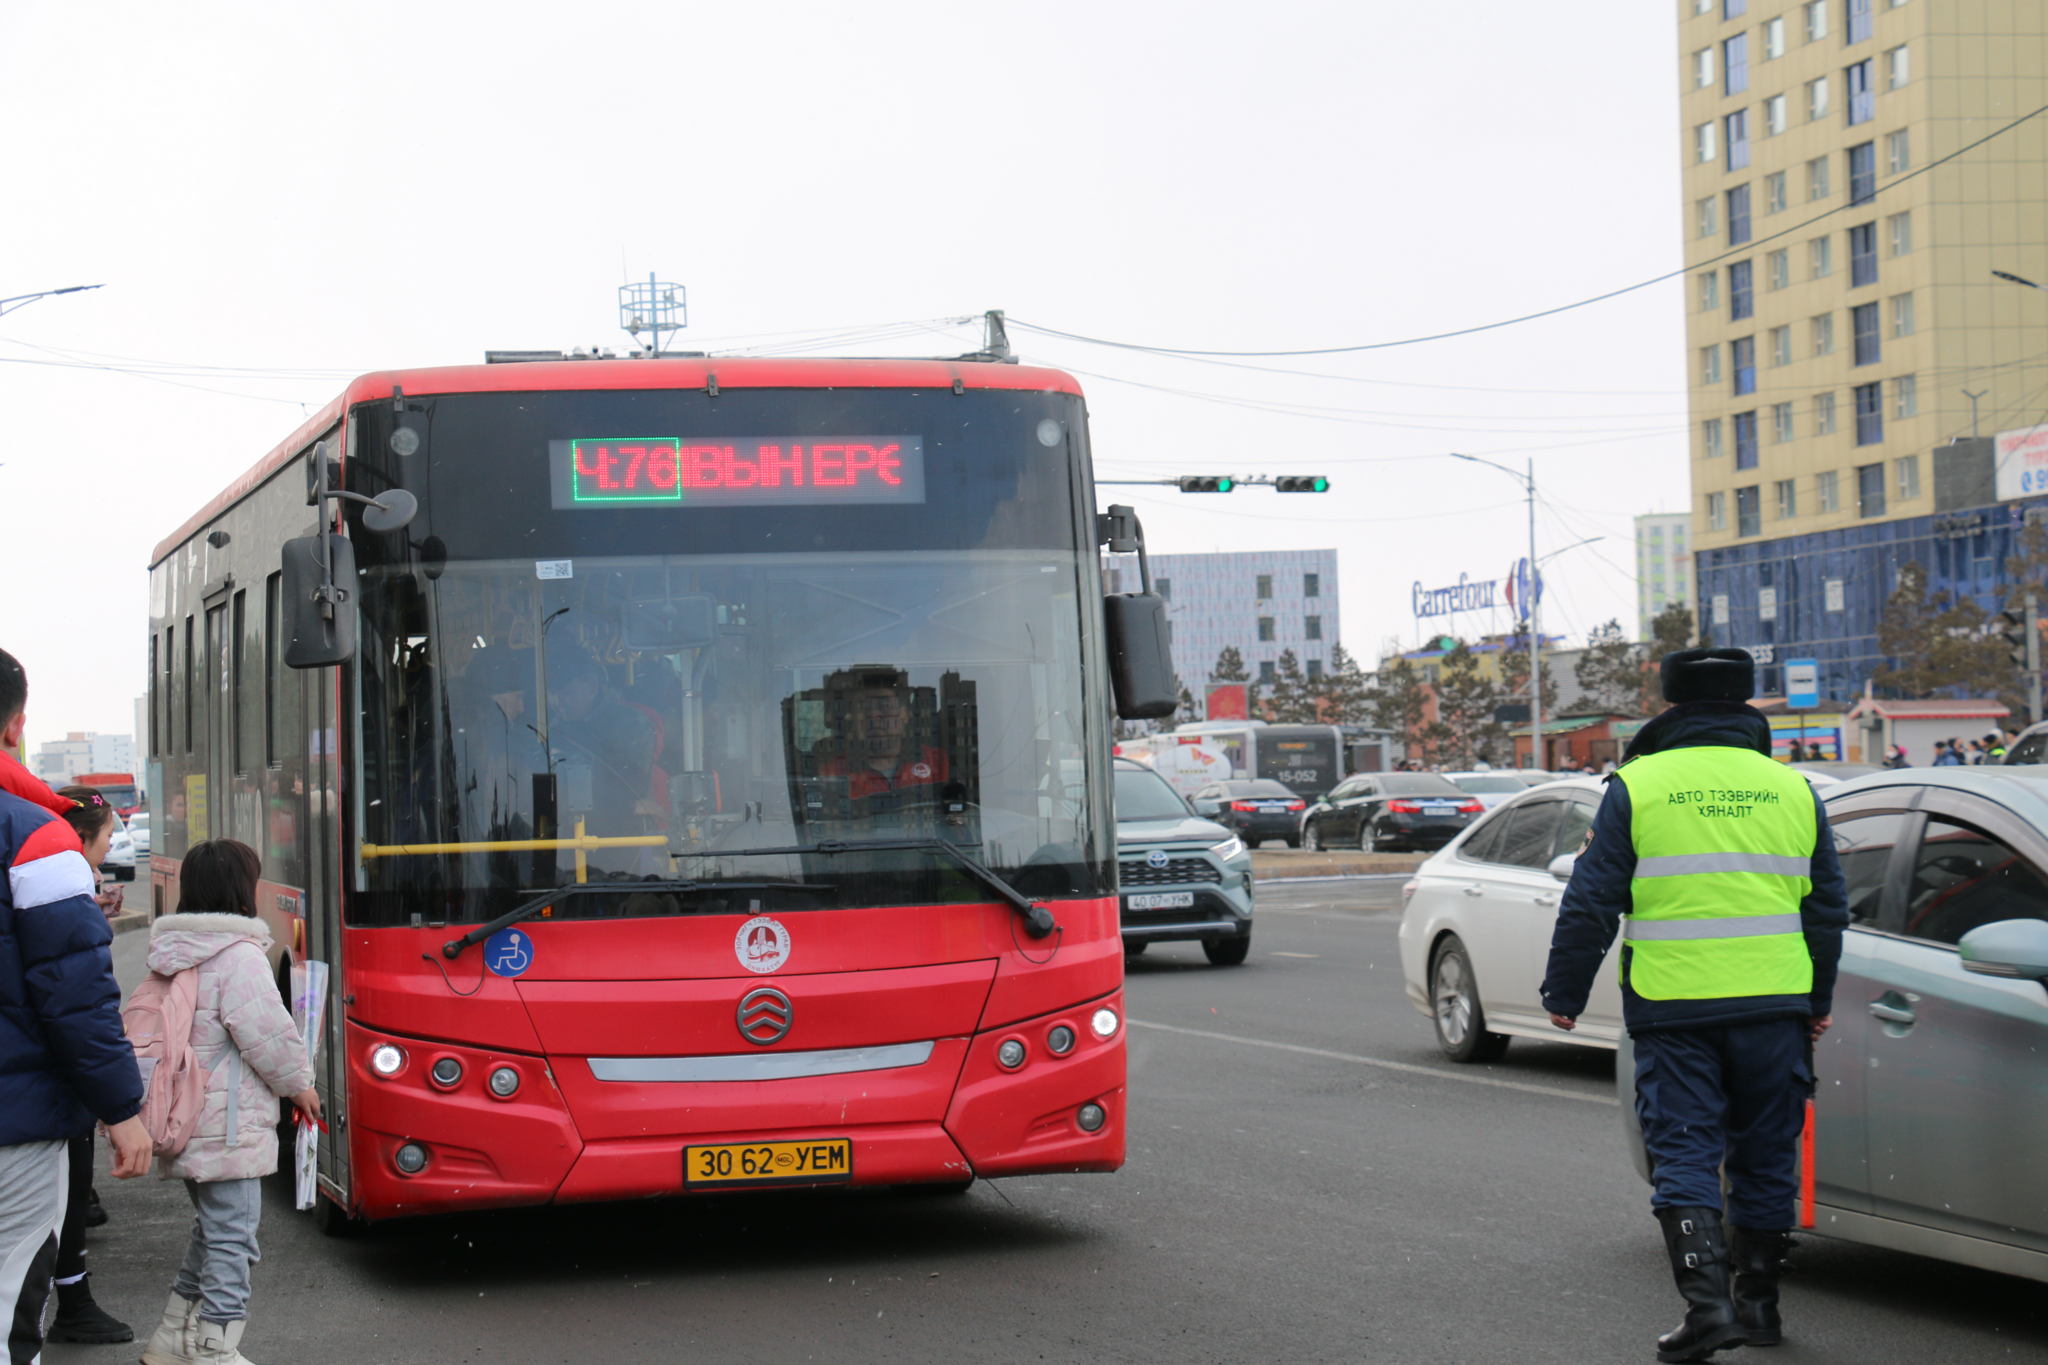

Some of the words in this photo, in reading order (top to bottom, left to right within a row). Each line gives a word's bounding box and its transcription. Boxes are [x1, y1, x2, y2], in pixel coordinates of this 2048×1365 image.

[1412, 572, 1497, 618] Carrefour
[1278, 769, 1318, 783] 15-052
[1668, 790, 1704, 805] АВТО
[1709, 789, 1780, 804] ТЭЭВРИЙН
[1697, 805, 1754, 818] ХЯНАЛТ
[1133, 896, 1147, 908] 40
[1149, 895, 1163, 907] 07
[700, 1149, 732, 1177] 30
[742, 1147, 774, 1175] 62
[796, 1145, 845, 1171] УЕМ
